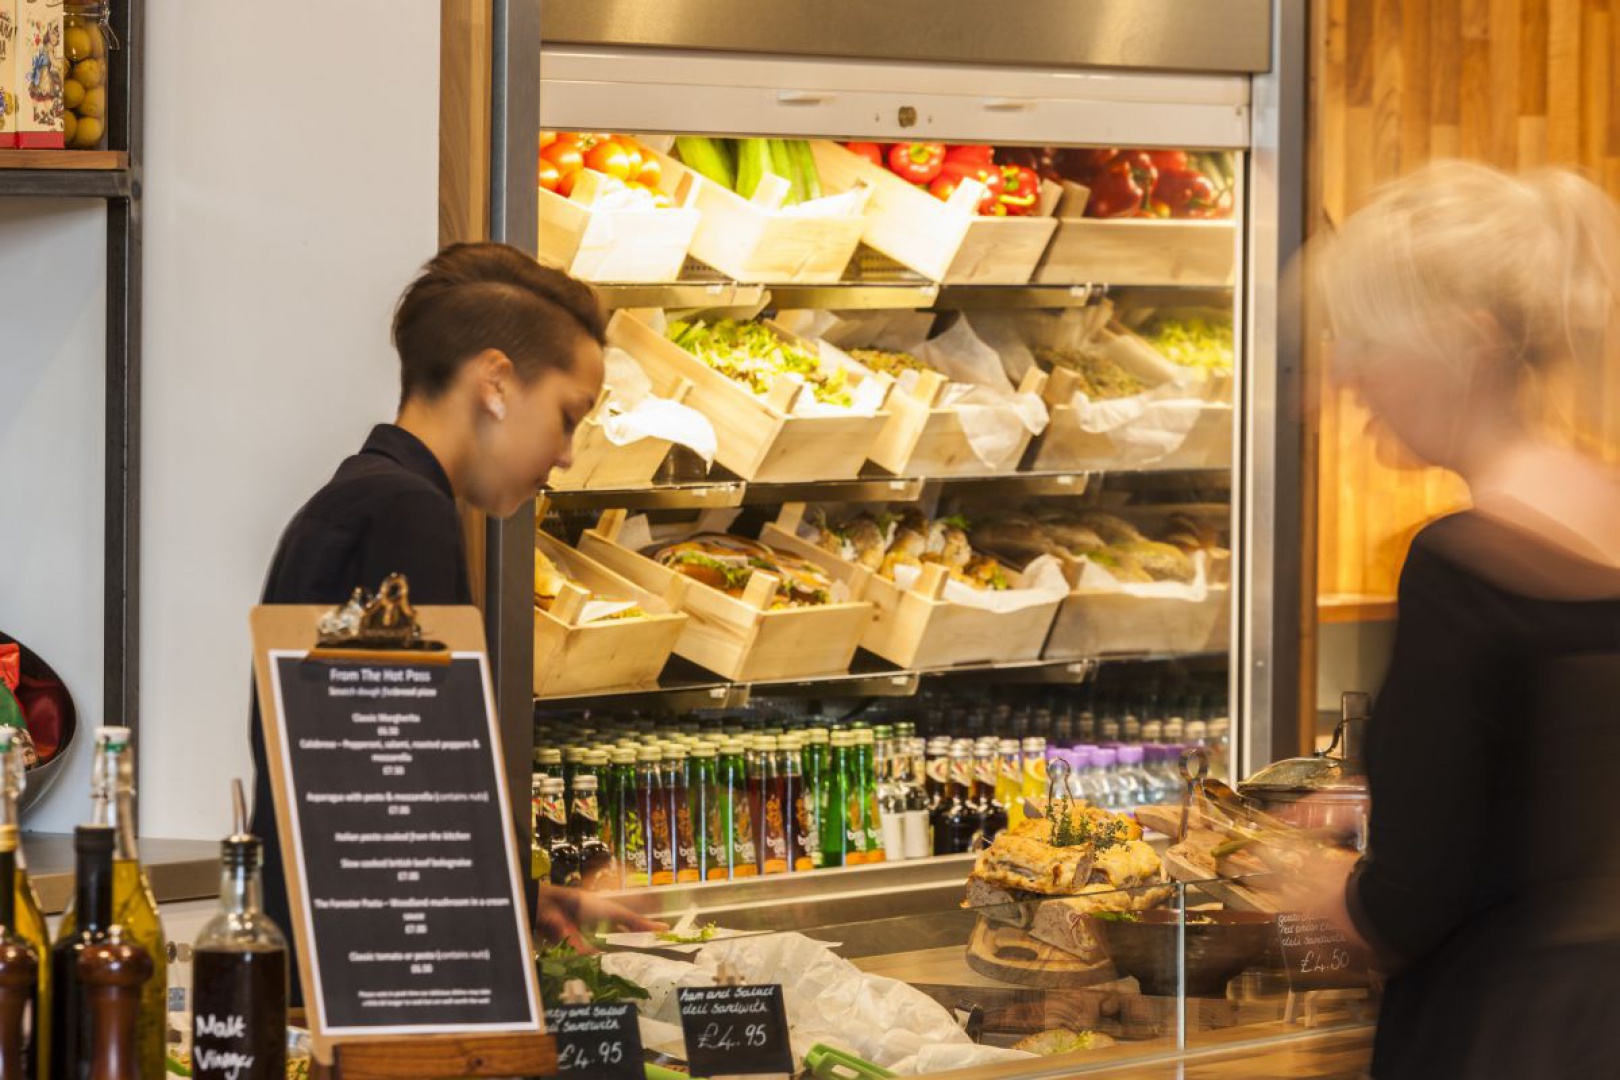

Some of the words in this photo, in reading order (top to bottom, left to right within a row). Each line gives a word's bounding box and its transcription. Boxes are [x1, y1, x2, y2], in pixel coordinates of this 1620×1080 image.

[329, 668, 359, 681] From
[361, 667, 381, 682] The
[383, 669, 404, 682] Hot
[405, 668, 431, 682] Pass
[1300, 948, 1350, 973] £4.50
[195, 1013, 247, 1038] Malt
[697, 1022, 768, 1050] £4.95
[557, 1041, 624, 1071] £4.95
